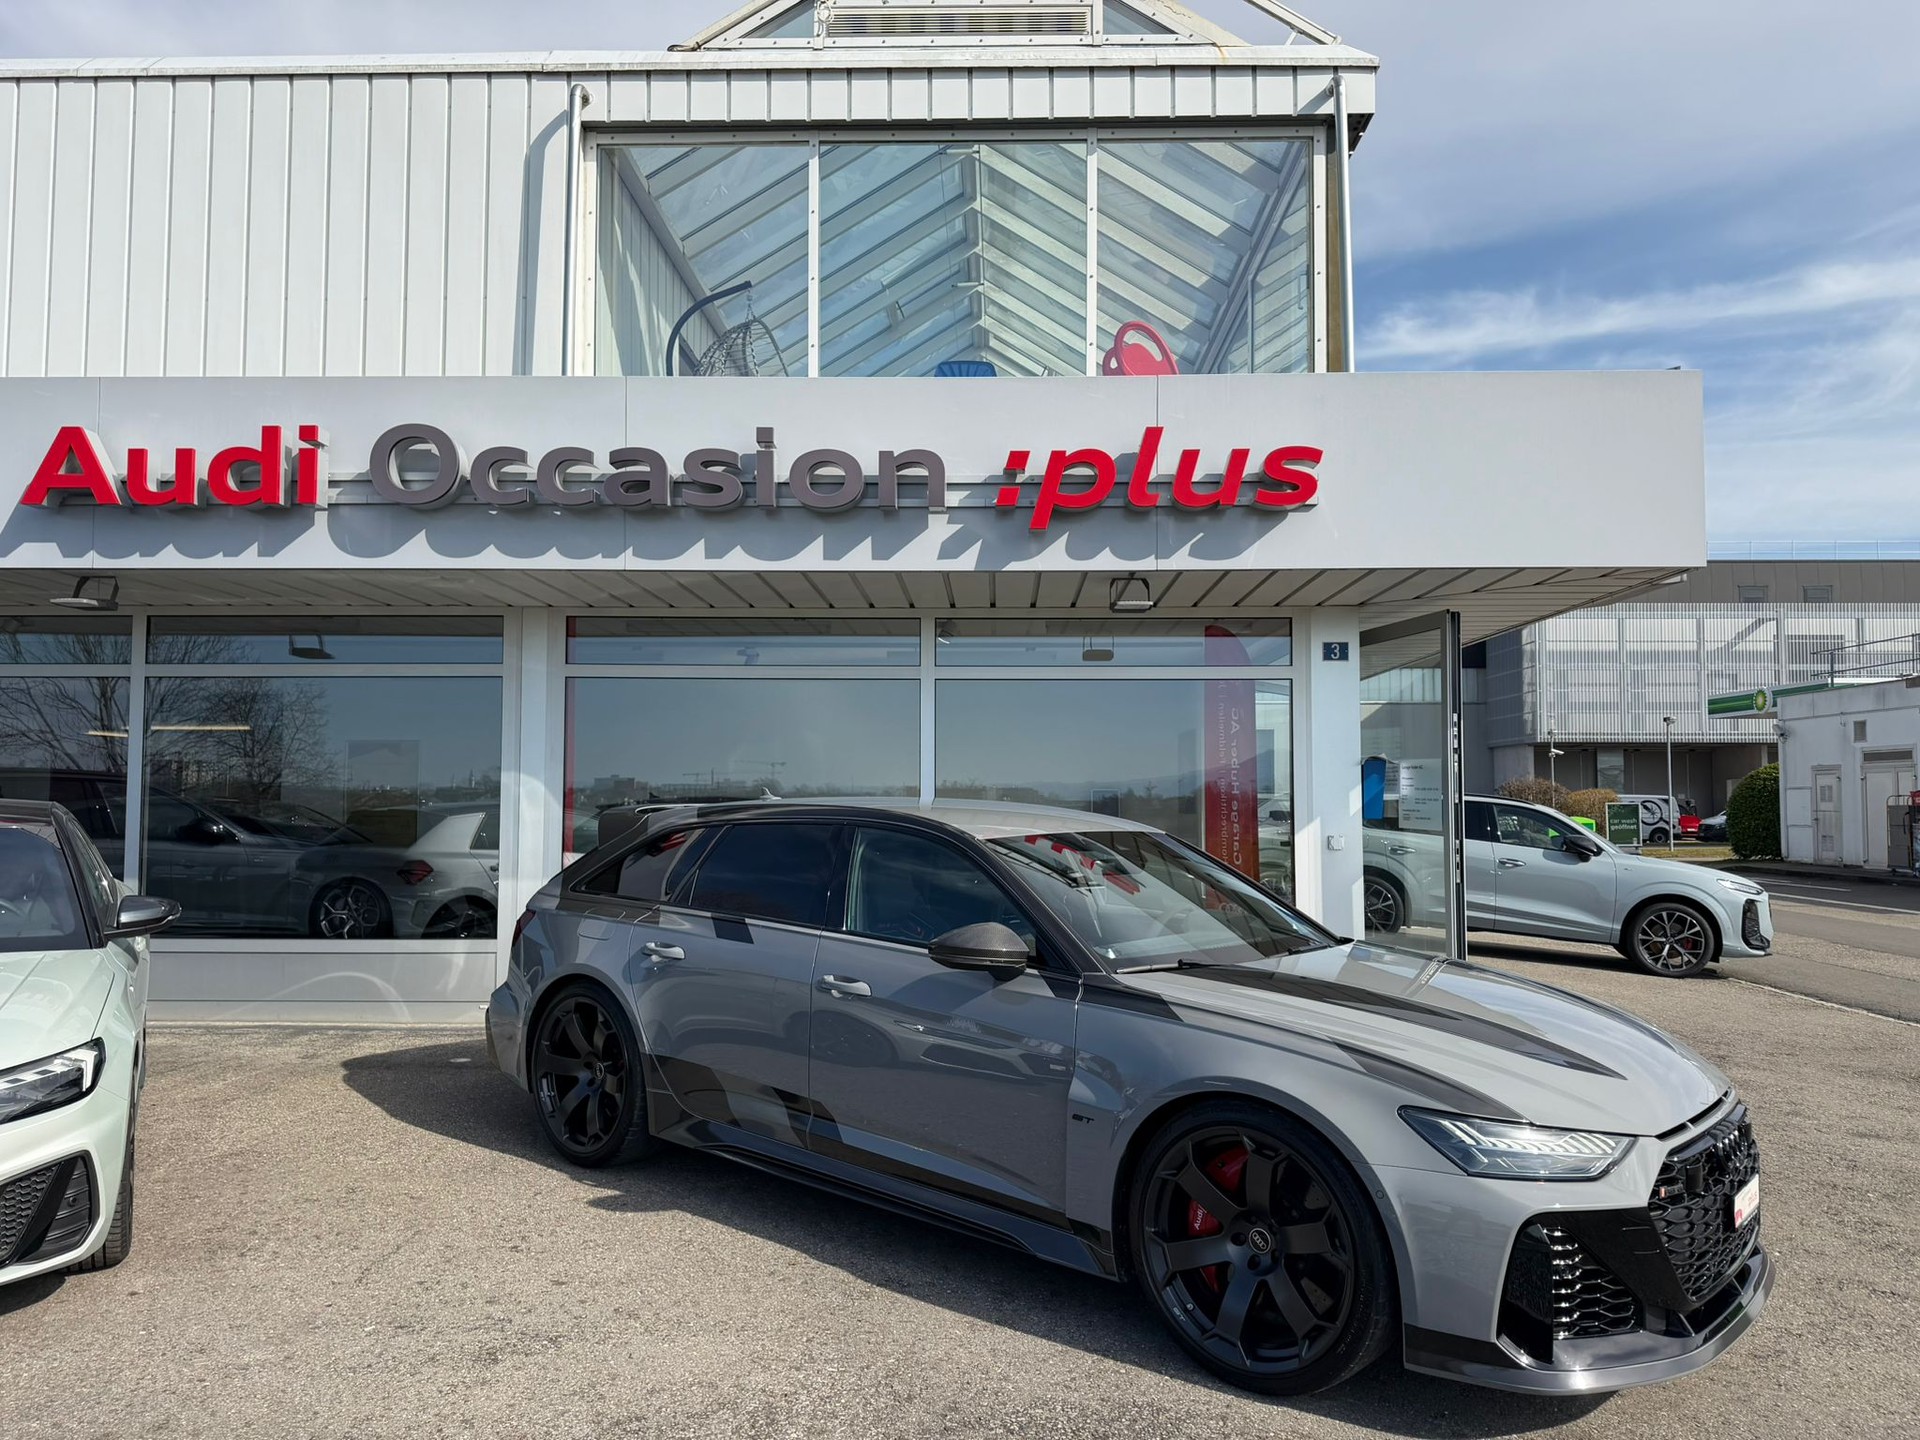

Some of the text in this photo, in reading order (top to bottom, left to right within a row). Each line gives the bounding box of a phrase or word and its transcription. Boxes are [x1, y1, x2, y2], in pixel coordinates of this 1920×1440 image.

[20, 422, 1324, 530] Audi Occasion :plus
[1331, 643, 1340, 660] 3
[1193, 1206, 1204, 1231] Audi
